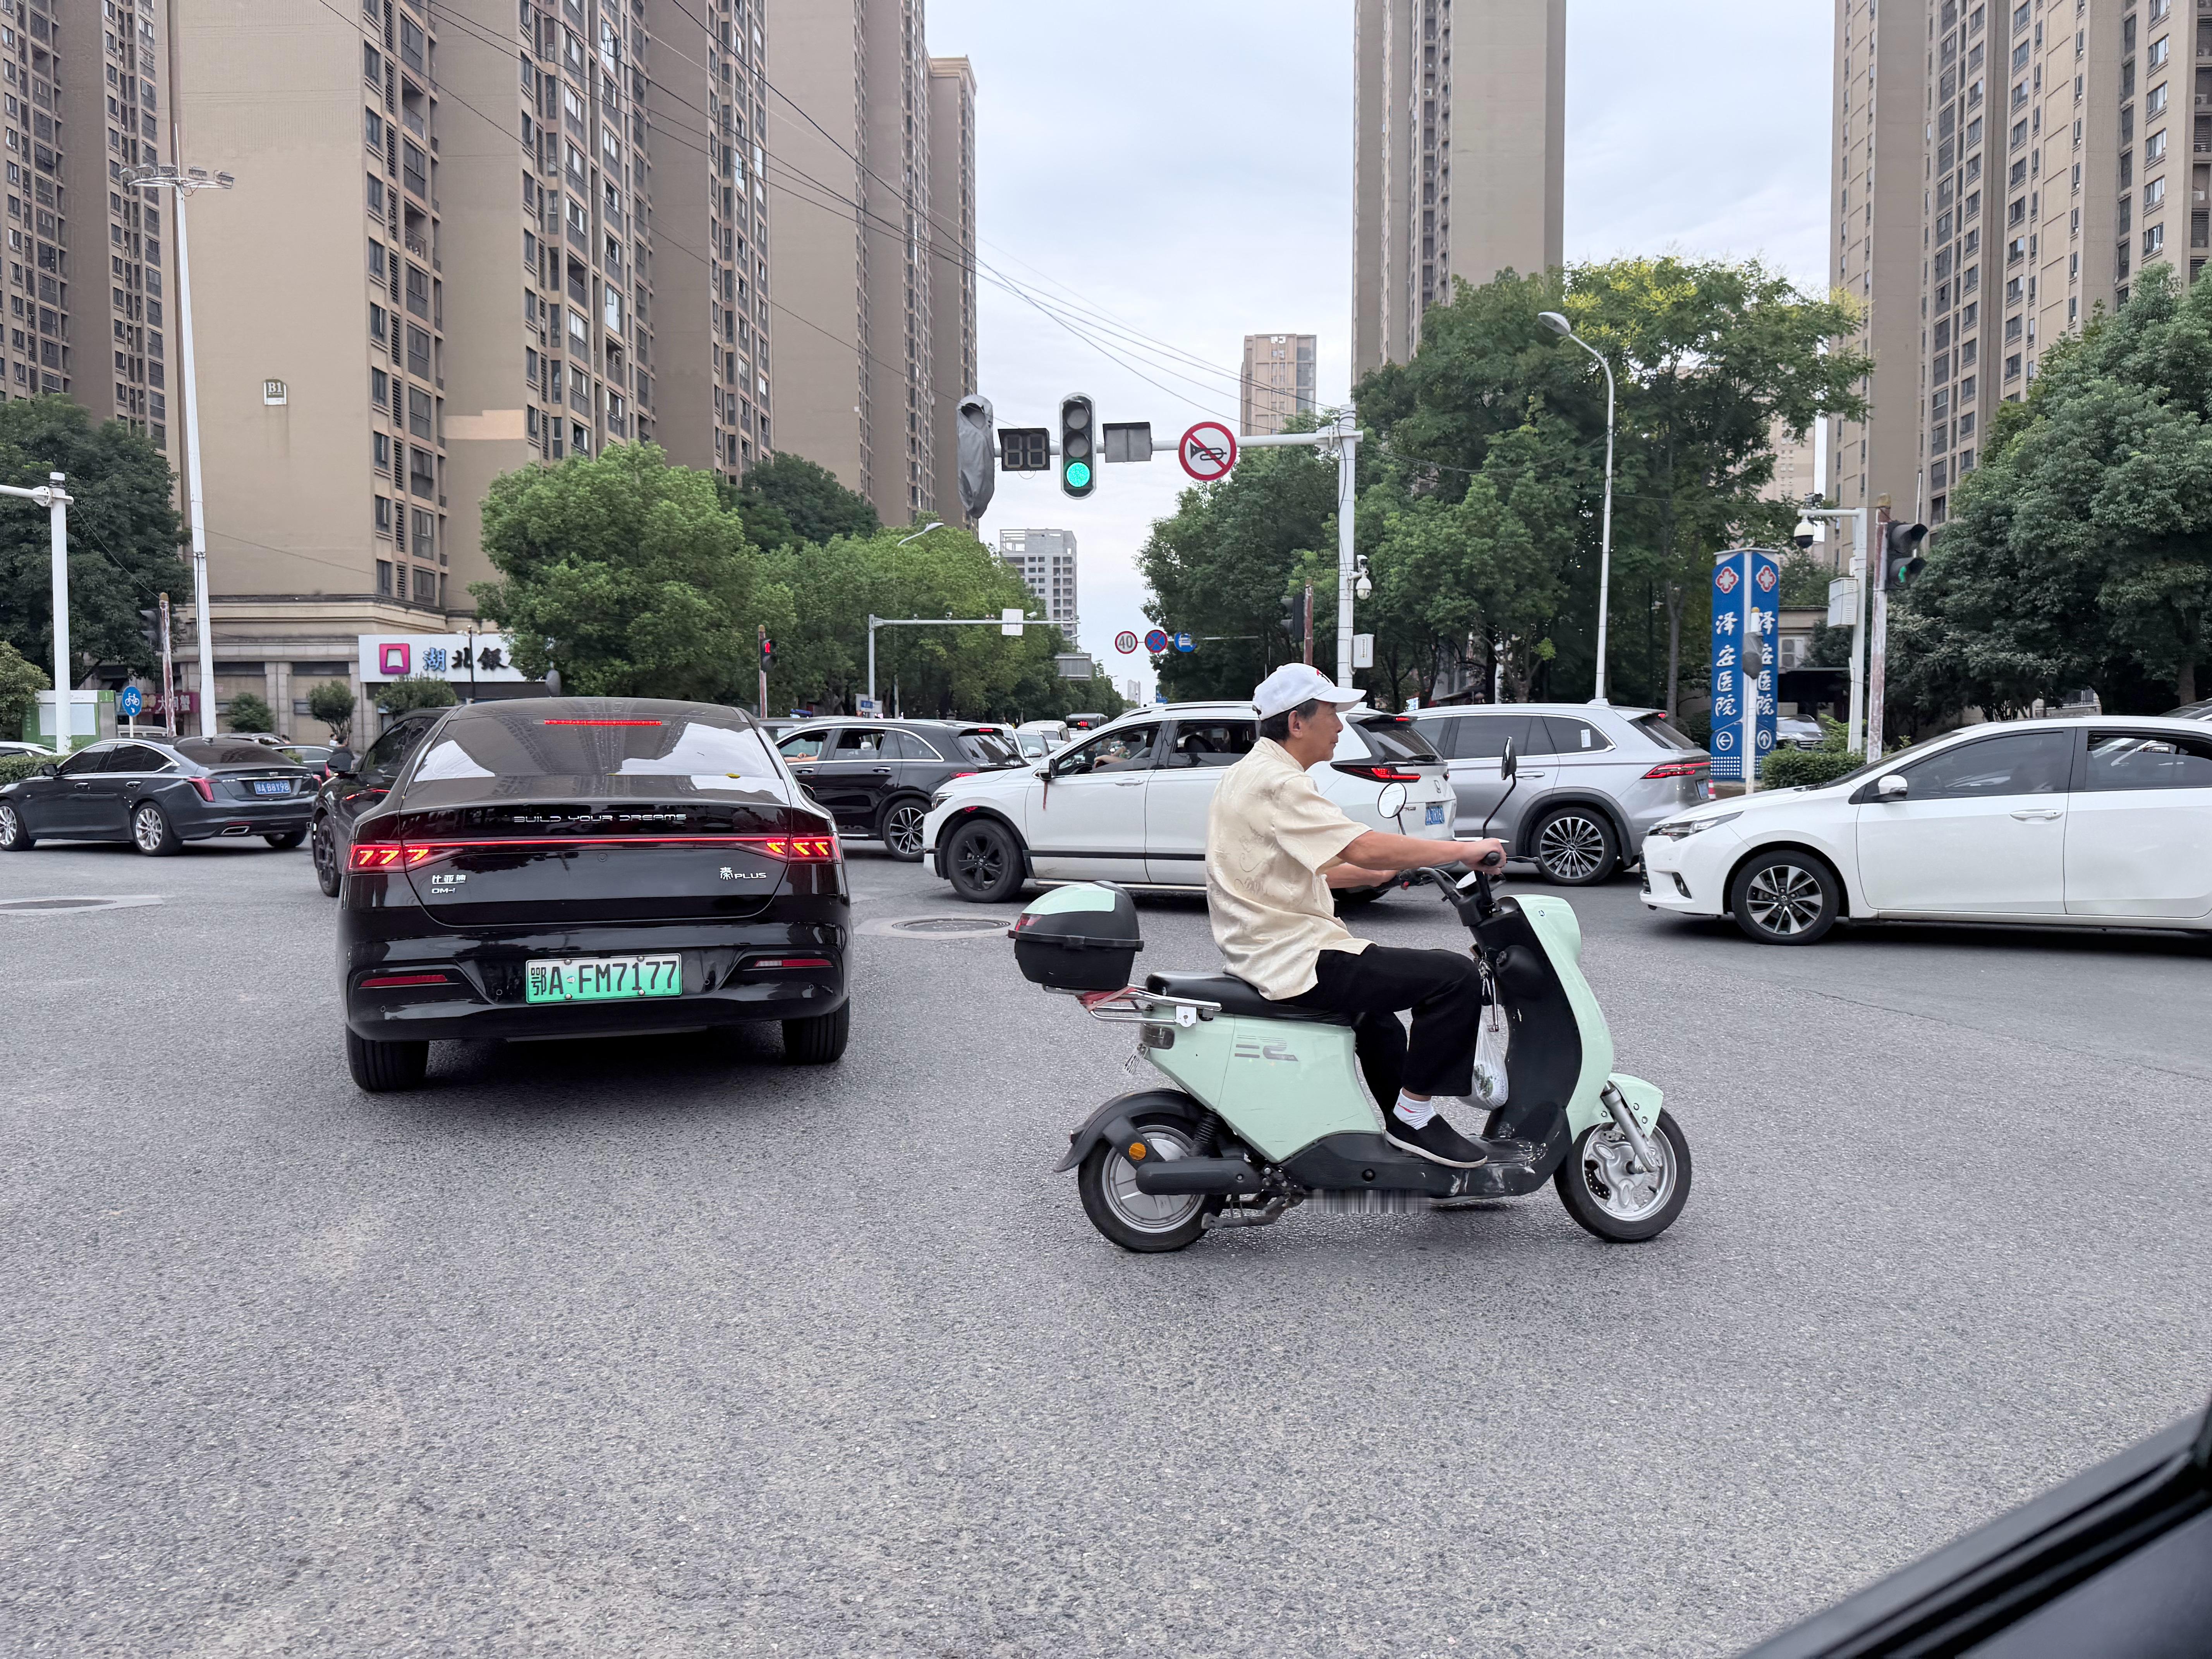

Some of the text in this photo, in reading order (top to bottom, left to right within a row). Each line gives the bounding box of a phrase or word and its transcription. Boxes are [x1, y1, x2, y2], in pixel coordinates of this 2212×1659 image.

[268, 382, 283, 393] B1
[1118, 635, 1133, 649] 40
[423, 647, 513, 672] 湖北银
[1715, 611, 1738, 717] 泽安医院
[432, 874, 466, 884] 比亚迪
